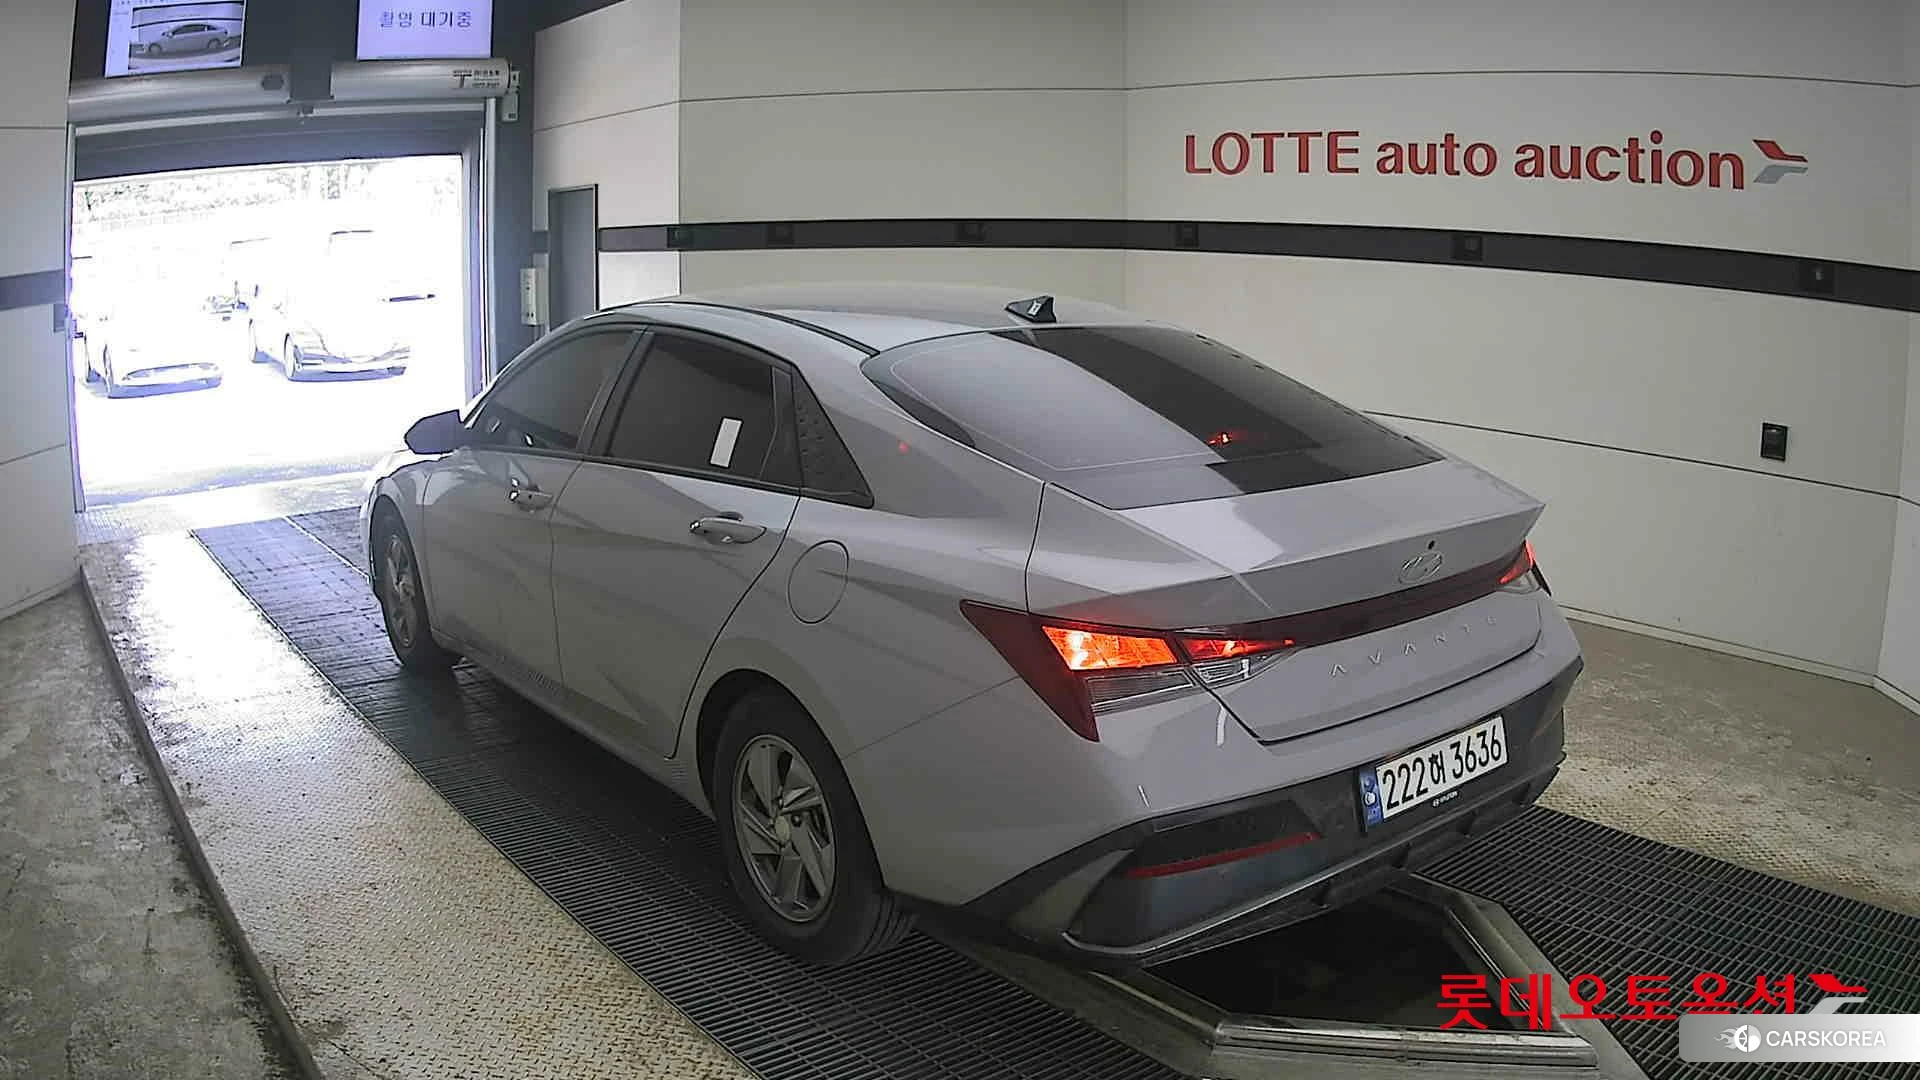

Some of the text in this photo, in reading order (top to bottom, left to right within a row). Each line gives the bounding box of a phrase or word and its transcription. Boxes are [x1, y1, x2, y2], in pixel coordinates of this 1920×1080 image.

[421, 10, 471, 28] 대기중
[1185, 130, 1745, 190] LOTTE auto auction
[1450, 724, 1502, 780] 3636
